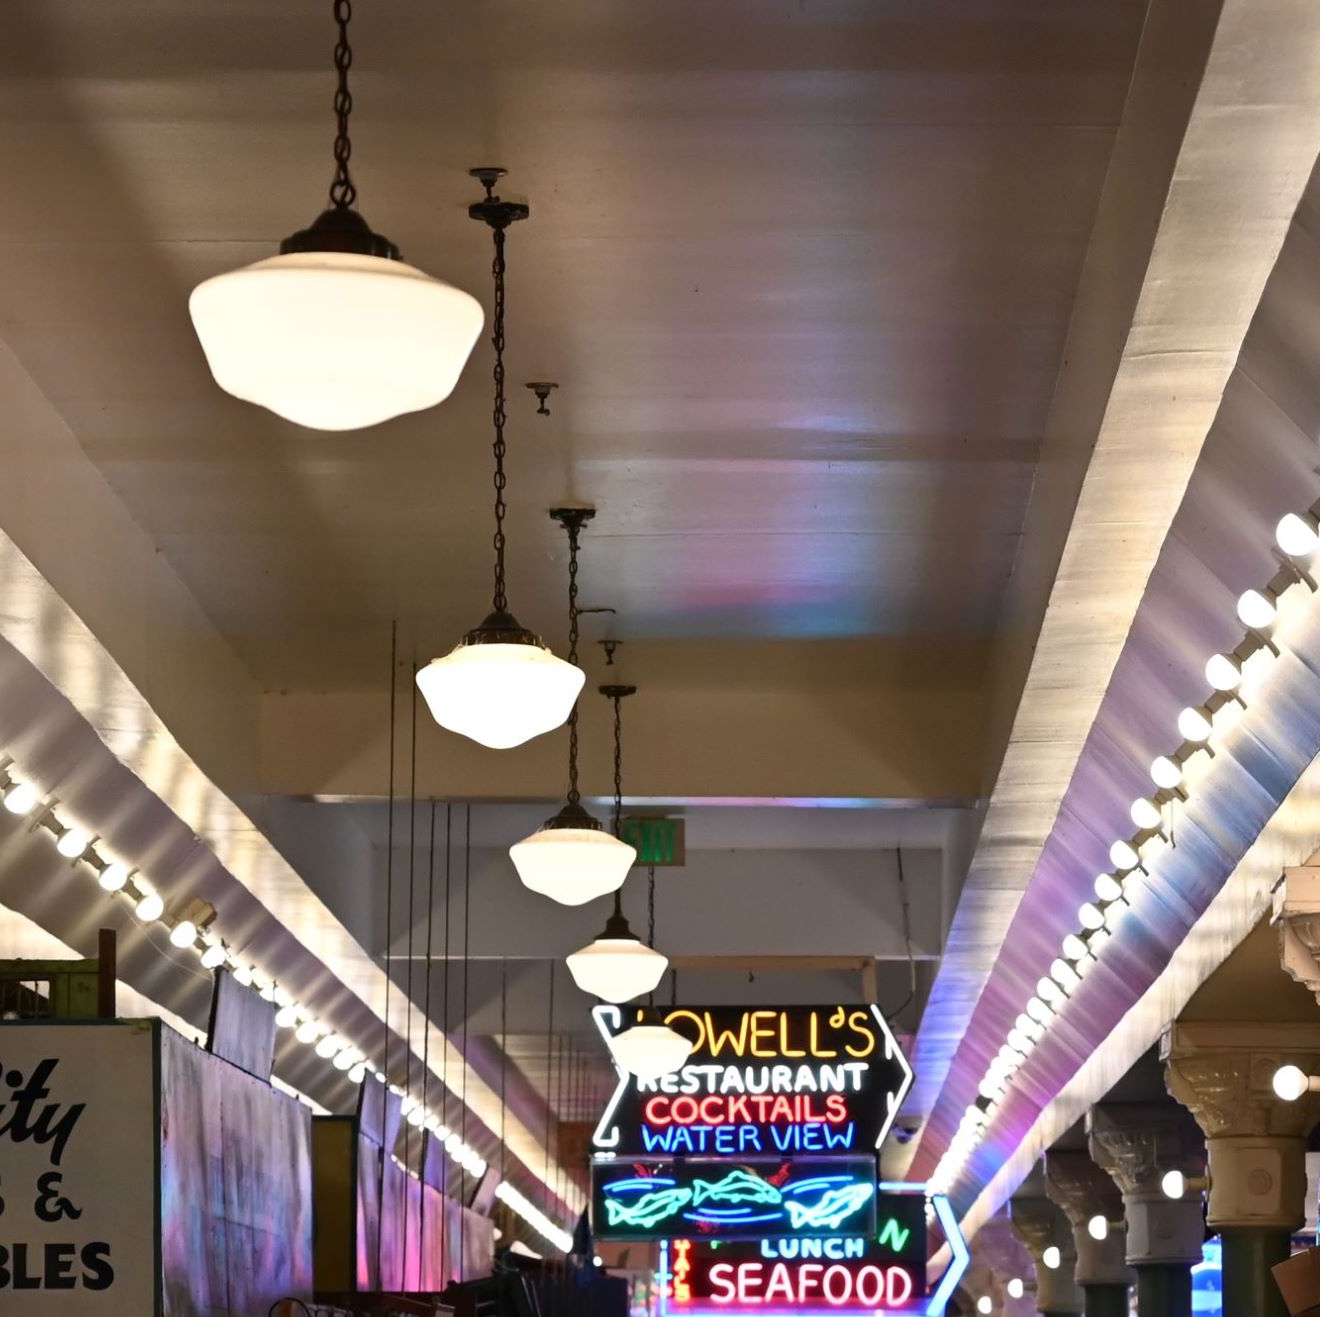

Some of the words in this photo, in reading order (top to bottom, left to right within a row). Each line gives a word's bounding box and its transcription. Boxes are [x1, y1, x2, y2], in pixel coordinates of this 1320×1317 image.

[637, 1006, 875, 1057] OWELL'S
[646, 1094, 847, 1124] COCKTAILS
[641, 1124, 762, 1152] WATER
[771, 1122, 855, 1151] VIEW
[34, 1171, 83, 1222] &
[761, 1238, 864, 1260] LUNCH
[709, 1262, 913, 1307] SEAFOOD
